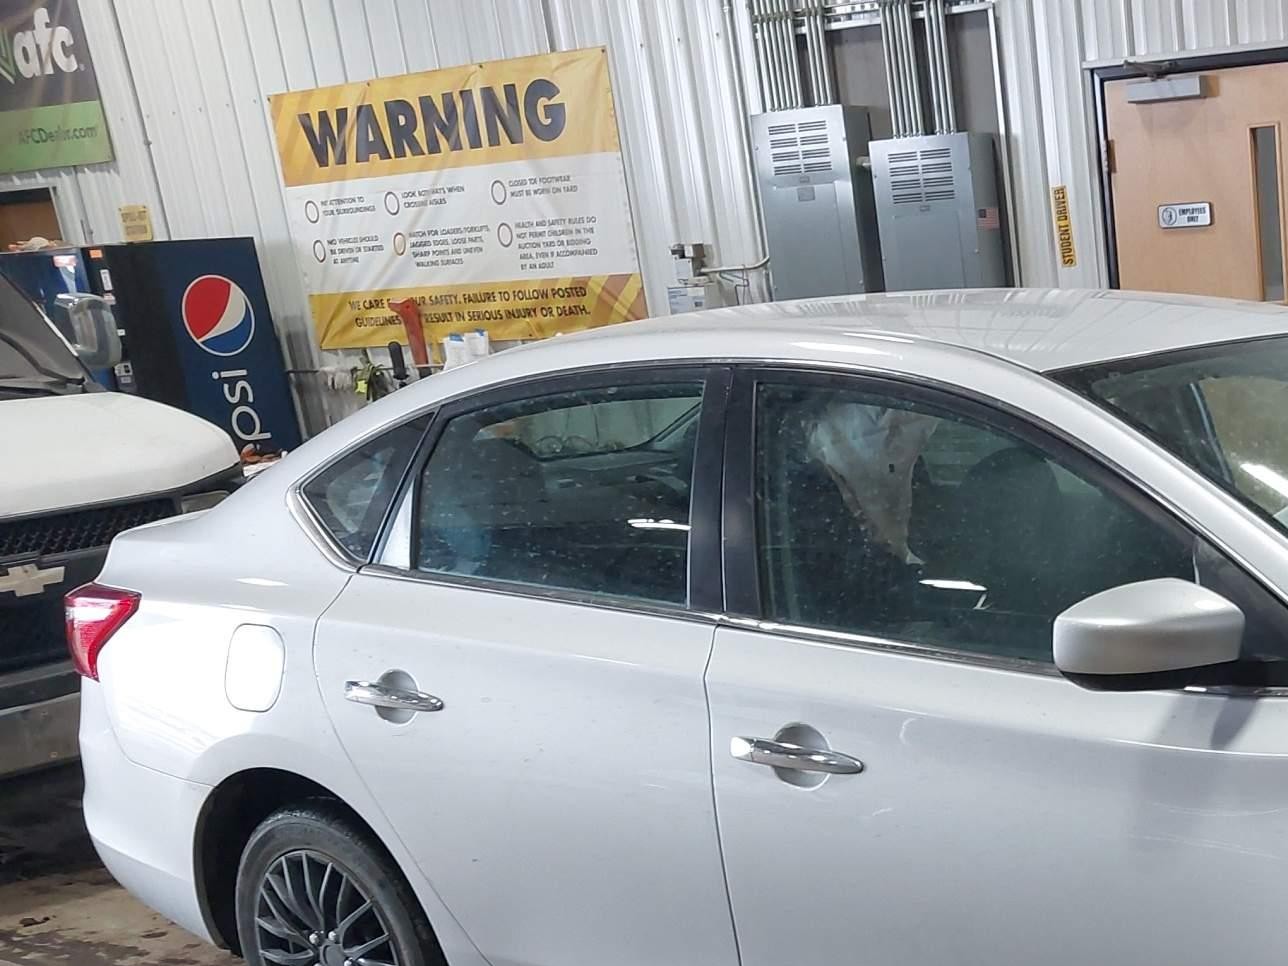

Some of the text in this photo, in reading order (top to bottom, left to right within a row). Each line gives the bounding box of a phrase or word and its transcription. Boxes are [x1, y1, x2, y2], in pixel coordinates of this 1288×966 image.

[14, 8, 78, 78] afc
[297, 78, 567, 168] WARNING
[1054, 188, 1074, 265] STUDENT DRIVER
[1178, 206, 1206, 216] EMPLOYEES
[349, 300, 362, 310] WE
[363, 299, 385, 310] CARE
[429, 293, 462, 306] SAFETY.
[463, 291, 497, 304] FAILURE
[499, 290, 510, 301] TO
[512, 288, 549, 300] FOLLOW
[551, 286, 587, 299] POSTED
[355, 304, 591, 328] GUIDELINES RESULT IN SERIOUS INJURY OR DEATH.
[211, 369, 272, 442] psi
